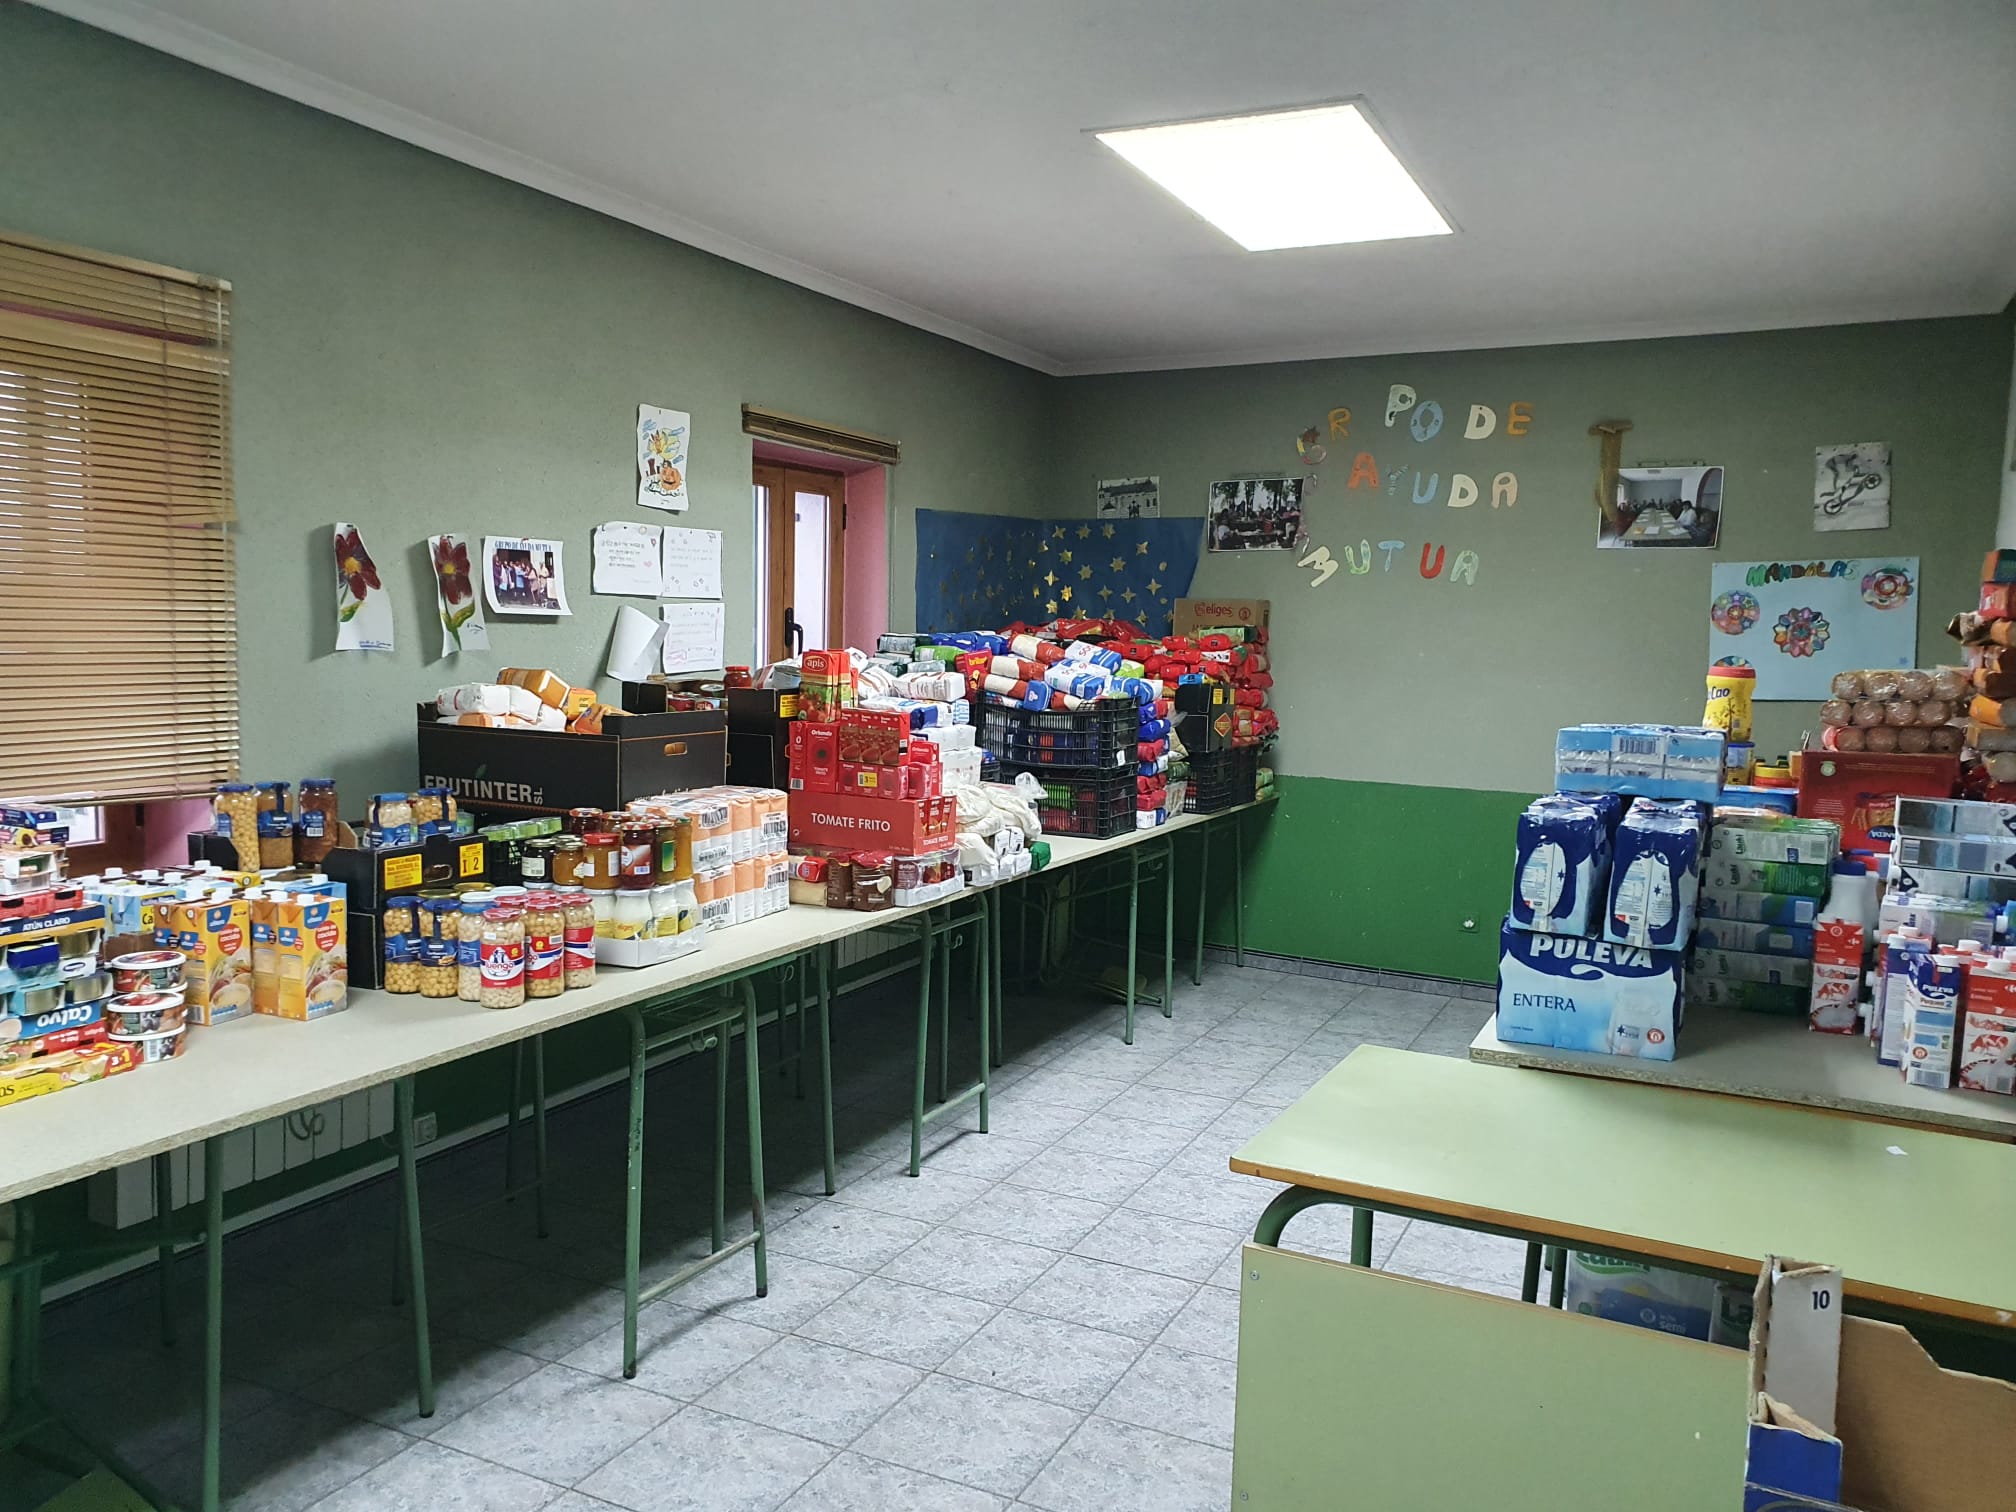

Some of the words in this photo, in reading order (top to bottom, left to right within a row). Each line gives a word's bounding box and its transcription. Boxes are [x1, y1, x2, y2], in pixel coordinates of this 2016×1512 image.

[1464, 402, 1534, 440] DE
[1347, 452, 1519, 508] AYUDA
[1297, 539, 1480, 588] MUTUA
[1746, 560, 1858, 587] MANDALAS
[806, 659, 825, 668] apis
[1710, 686, 1731, 700] Cao
[811, 811, 855, 829] TOMATE
[858, 817, 891, 832] FRITO
[473, 856, 479, 871] 2
[22, 920, 43, 932] ATÚN
[44, 917, 71, 928] CLARO
[1530, 936, 1653, 969] PULEVA
[486, 960, 514, 971] luengo
[1921, 984, 1954, 994] PULEVA
[1513, 993, 1577, 1013] ENTERA
[37, 1004, 92, 1028] Calvo
[1812, 1289, 1831, 1310] 10
